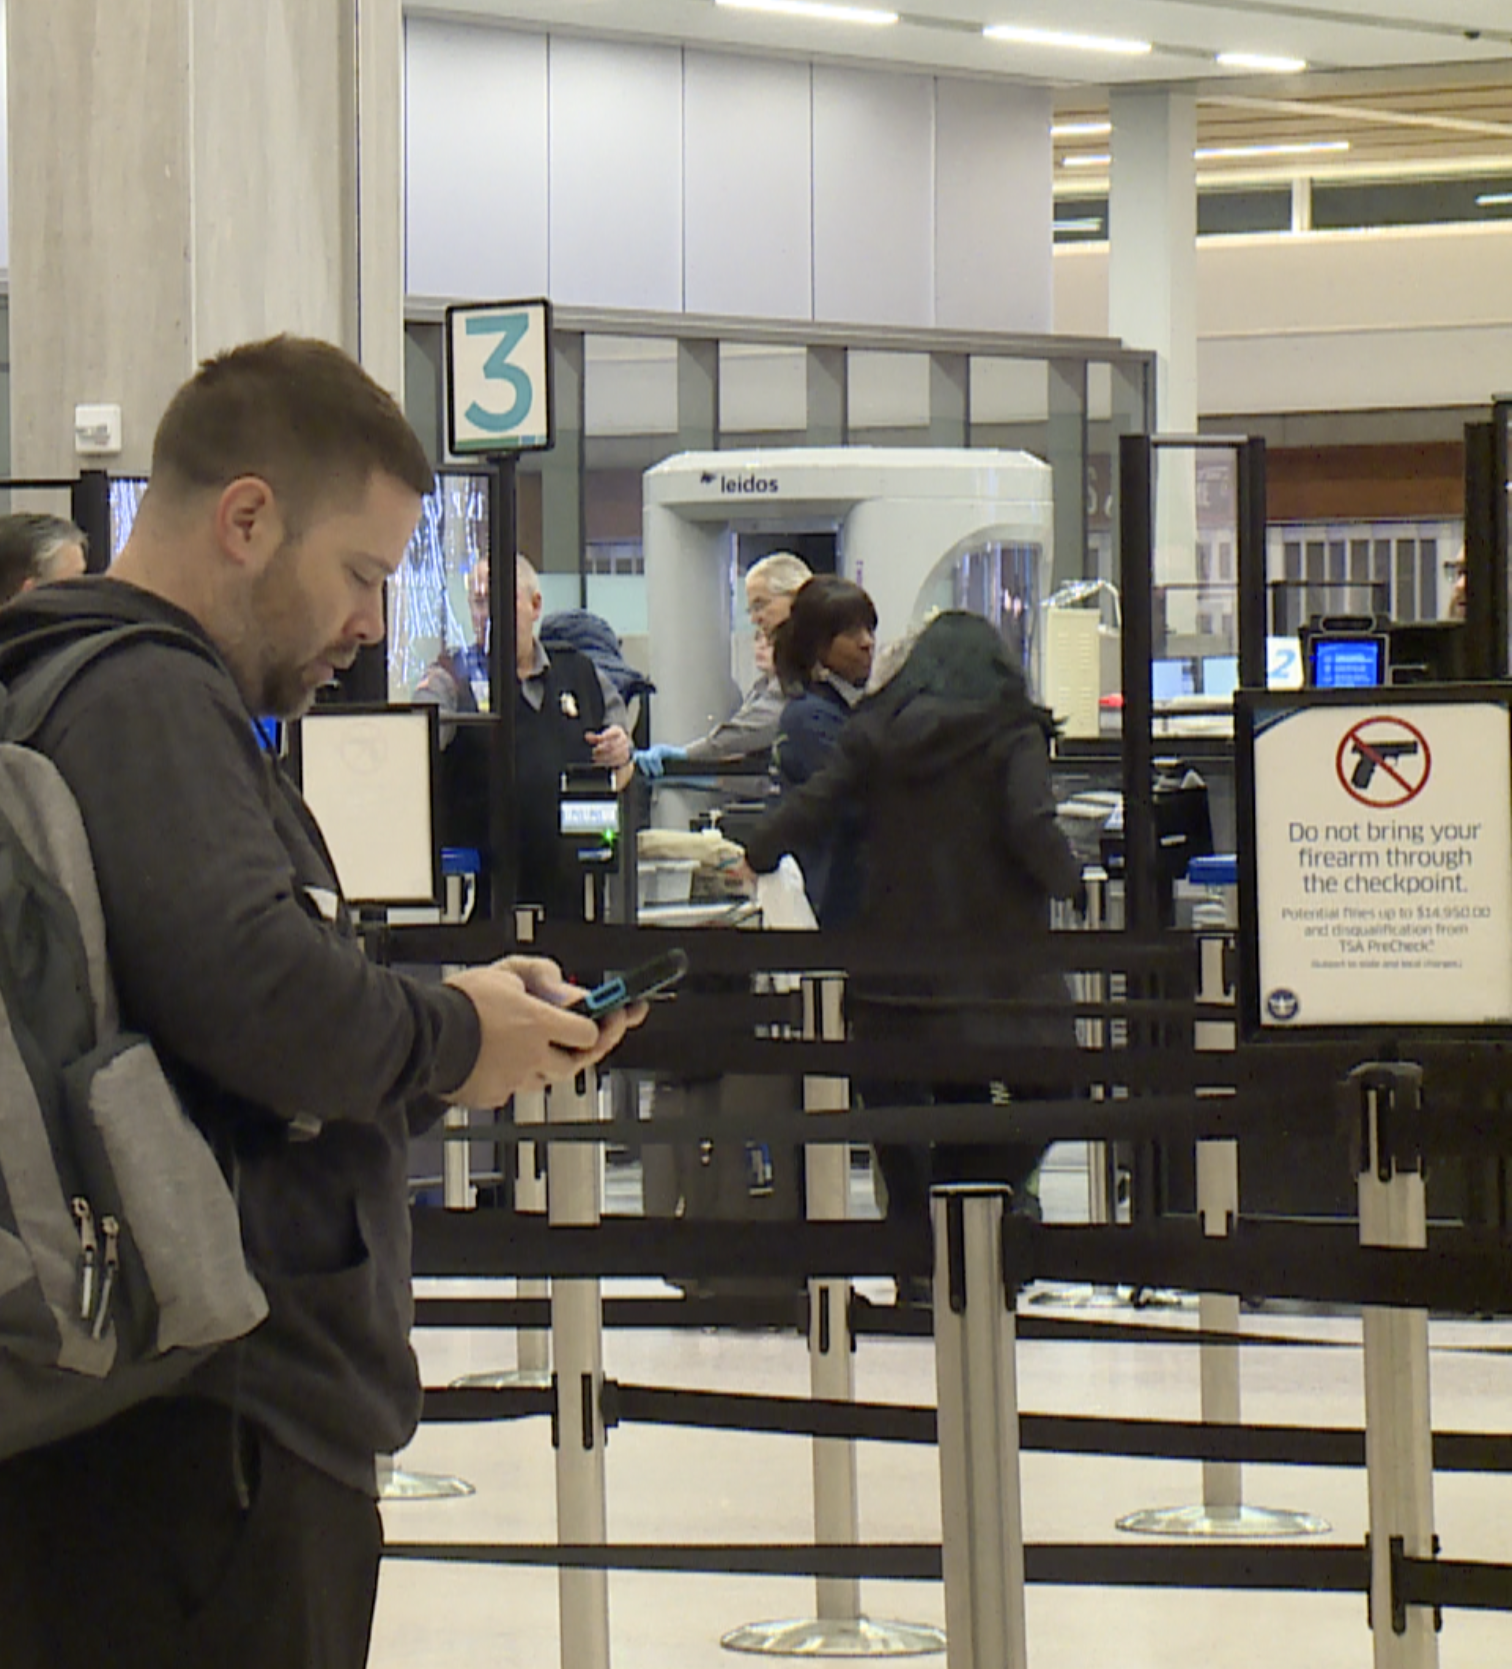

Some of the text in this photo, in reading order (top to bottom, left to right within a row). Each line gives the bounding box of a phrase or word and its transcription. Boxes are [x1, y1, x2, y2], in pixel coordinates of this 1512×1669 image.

[464, 312, 533, 433] 3
[721, 473, 779, 494] leidos
[1269, 649, 1296, 679] 2
[1289, 820, 1482, 845] Do not bring your
[1299, 847, 1472, 870] firearm through
[1303, 873, 1469, 895] the checkpoint.
[1281, 907, 1339, 919] Potential
[1343, 907, 1375, 919] fines
[1378, 907, 1396, 921] up
[1399, 907, 1413, 919] to
[1304, 923, 1469, 938] and disqualification from
[1339, 939, 1364, 953] TSA
